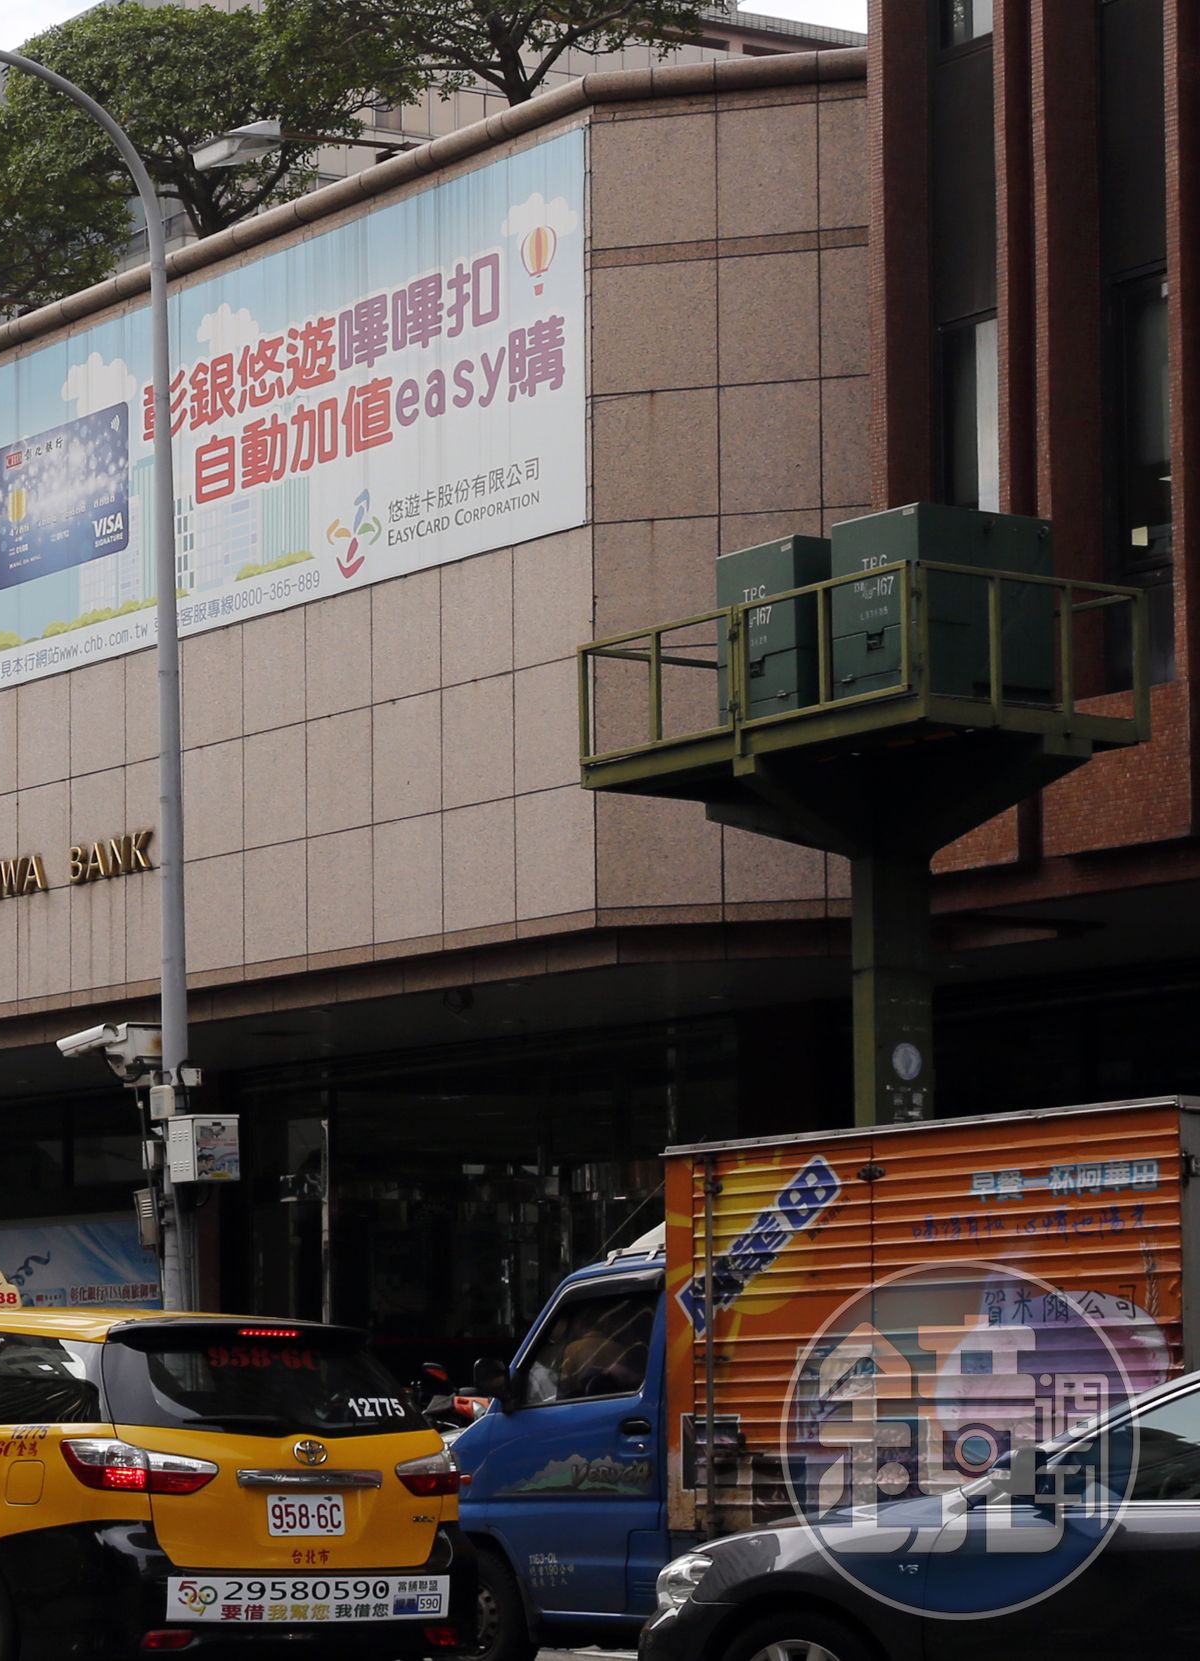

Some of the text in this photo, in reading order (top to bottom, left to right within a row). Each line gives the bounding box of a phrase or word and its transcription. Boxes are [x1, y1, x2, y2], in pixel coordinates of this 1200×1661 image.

[195, 315, 565, 504] 自動加值easy購
[388, 457, 539, 524] 悠遊卡股份有限公司
[92, 512, 123, 537] VISA
[862, 554, 888, 571] TPC
[743, 584, 767, 603] TPC
[70, 829, 153, 885] BANK
[972, 1160, 1159, 1204] 早餐一杯阿華田
[348, 1397, 406, 1417] 12775
[11, 1426, 50, 1440] 12775
[271, 1503, 342, 1530] 958-6C
[291, 1550, 331, 1565] 台北市
[224, 1580, 390, 1601] 29580590
[419, 1598, 439, 1609] 590
